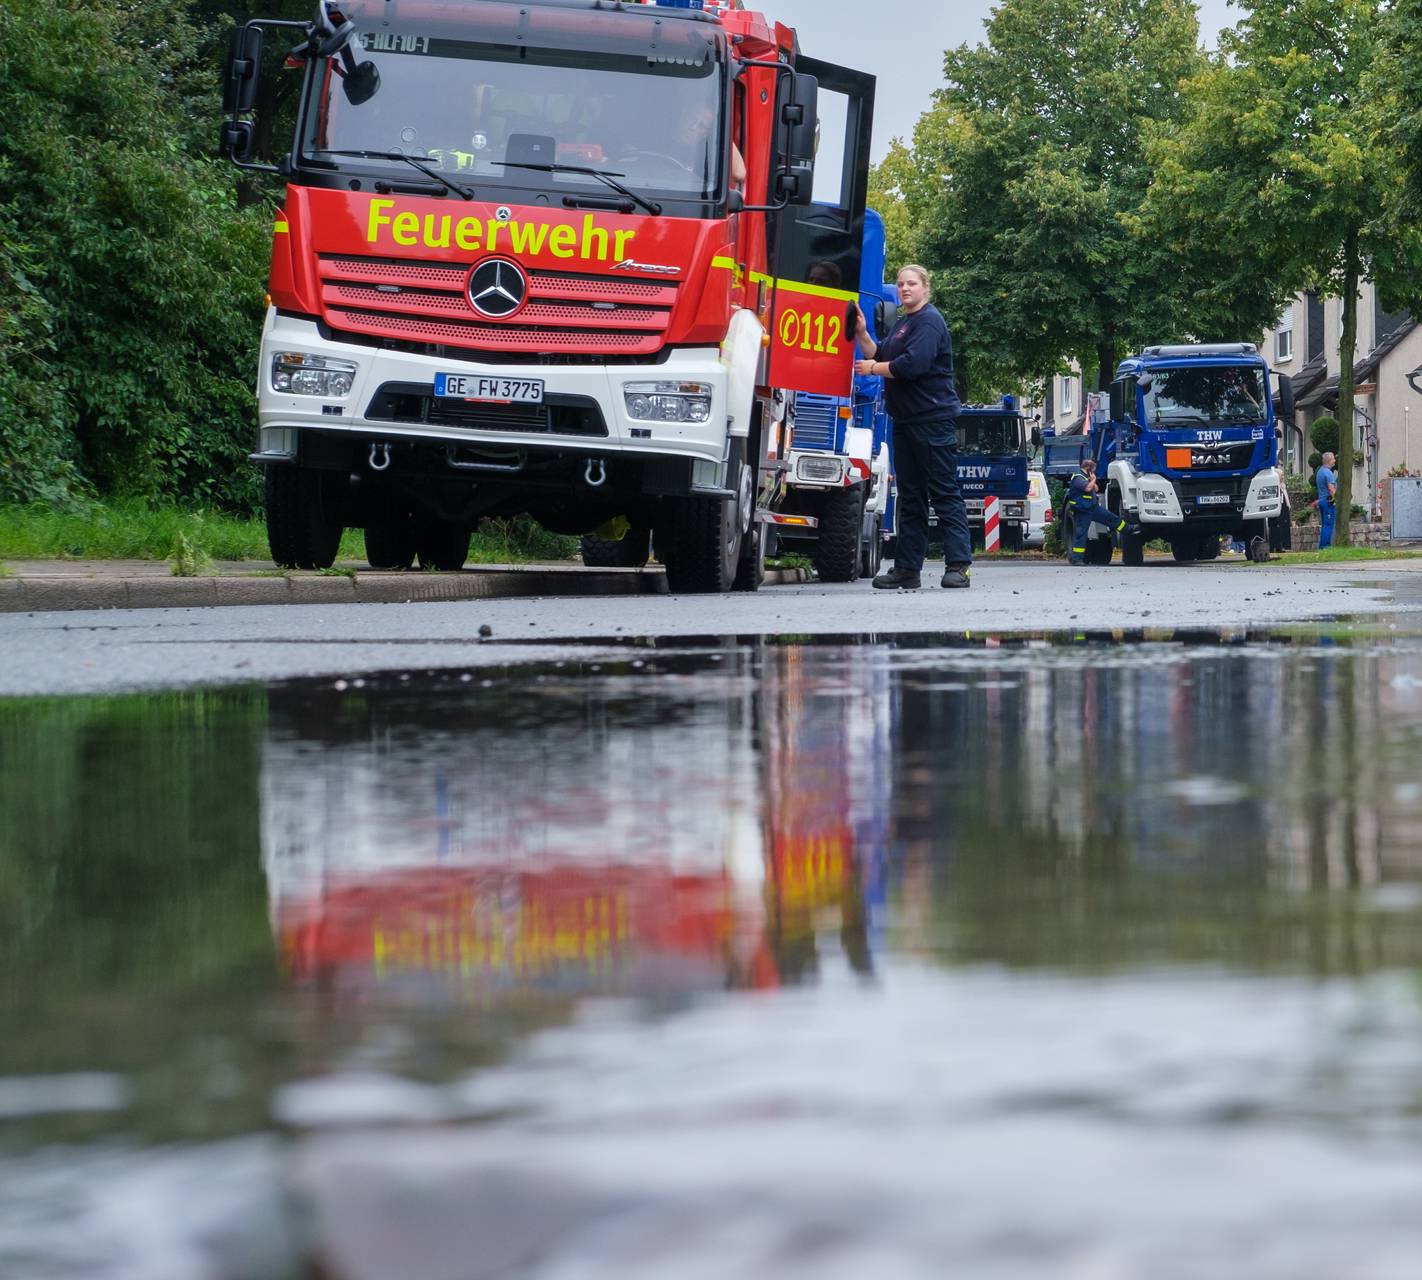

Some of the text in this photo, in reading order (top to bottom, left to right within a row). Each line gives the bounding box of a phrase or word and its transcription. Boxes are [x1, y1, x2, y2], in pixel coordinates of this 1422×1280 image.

[366, 199, 636, 262] Feuerwehr
[800, 311, 840, 354] 112
[447, 377, 541, 399] GE FW 3775
[1196, 429, 1223, 441] THW
[1192, 454, 1231, 464] MAN
[956, 466, 992, 478] THW
